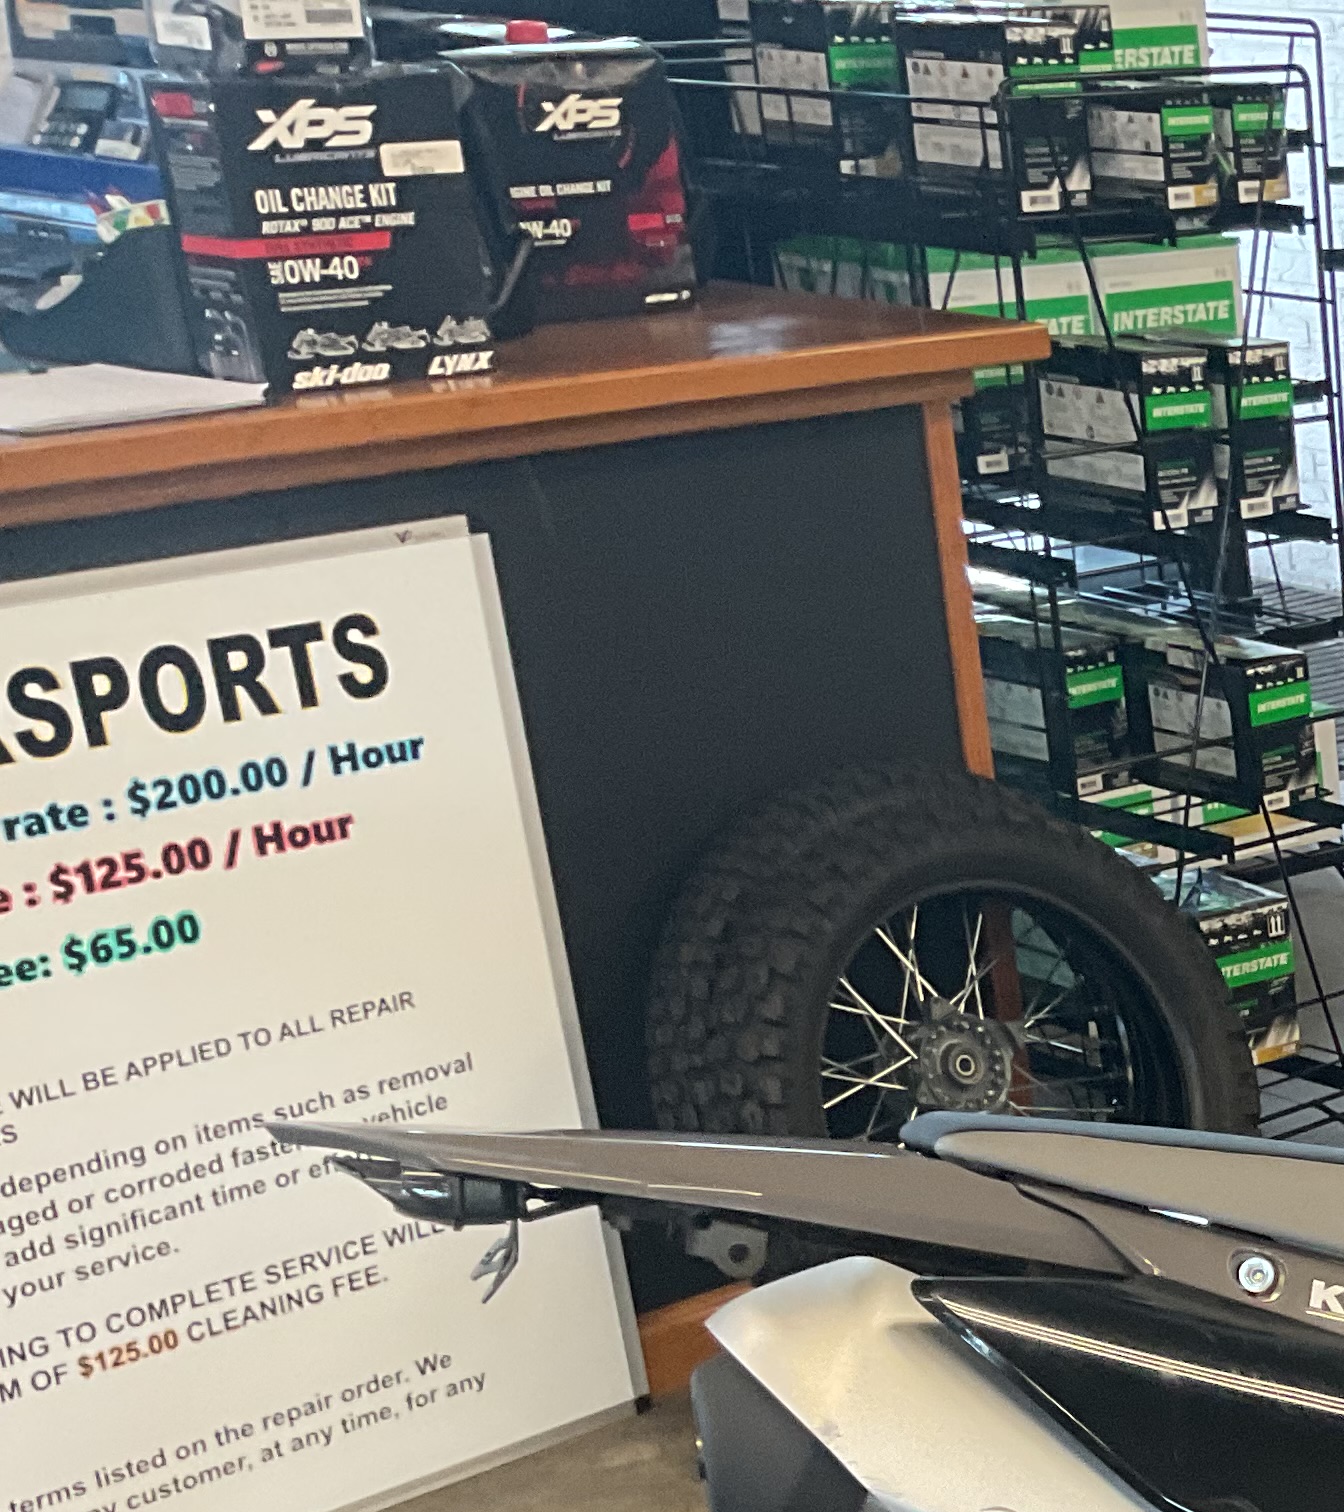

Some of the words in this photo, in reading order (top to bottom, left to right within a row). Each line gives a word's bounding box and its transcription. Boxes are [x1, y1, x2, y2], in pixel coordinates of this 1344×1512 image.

[247, 98, 377, 150] XPS
[535, 93, 623, 131] XPS
[254, 189, 288, 214] OIL
[290, 184, 367, 211] CHANGE
[368, 182, 397, 207] KIT
[519, 218, 573, 239] W-40
[284, 255, 359, 283] 0W-40
[1113, 300, 1230, 333] INTERSTATE
[292, 362, 391, 390] ski-doo
[428, 351, 495, 376] LYNX
[0, 613, 390, 764] SPORTS
[2, 801, 90, 842] rate
[127, 755, 288, 818] $200.00
[300, 749, 316, 787] /
[328, 736, 425, 775] Hour
[48, 837, 212, 904] $125.00
[224, 828, 241, 870] /
[252, 813, 354, 857] Hour
[62, 909, 201, 976] $65.00
[8, 1079, 76, 1110] WILL
[81, 1066, 119, 1092] BE
[125, 1038, 232, 1082] APPLIED
[237, 1027, 272, 1050] TO
[279, 1015, 324, 1042] ALL
[330, 991, 416, 1029] REPAIR
[0, 1145, 147, 1197] depending
[154, 1133, 187, 1156] on
[195, 1112, 265, 1144] items
[274, 1090, 336, 1122] such
[343, 1083, 371, 1104] as
[378, 1051, 474, 1095] removal
[4, 1234, 57, 1267] add
[64, 1193, 205, 1250] significant
[211, 1179, 266, 1207] time
[275, 1168, 300, 1188] or
[67, 1192, 96, 1214] or
[104, 1153, 224, 1204] corroded
[1, 1271, 65, 1309] your
[75, 1240, 180, 1281] service.
[56, 1321, 97, 1349] TO
[105, 1271, 258, 1334] COMPLETE
[264, 1234, 378, 1285] SERVICE
[31, 1363, 68, 1391] OF
[77, 1328, 180, 1378] $125.00
[187, 1284, 324, 1342] CLEANING
[331, 1264, 389, 1298] FEE.
[94, 1448, 167, 1489] listed
[175, 1438, 208, 1461] on
[214, 1422, 254, 1447] the
[262, 1392, 334, 1427] repair
[340, 1369, 411, 1403] order.
[414, 1353, 452, 1376] We
[126, 1454, 254, 1511] customer,
[261, 1440, 285, 1463] at
[291, 1424, 333, 1453] any
[340, 1405, 400, 1434] time,
[405, 1387, 439, 1411] for
[446, 1372, 486, 1398] any
